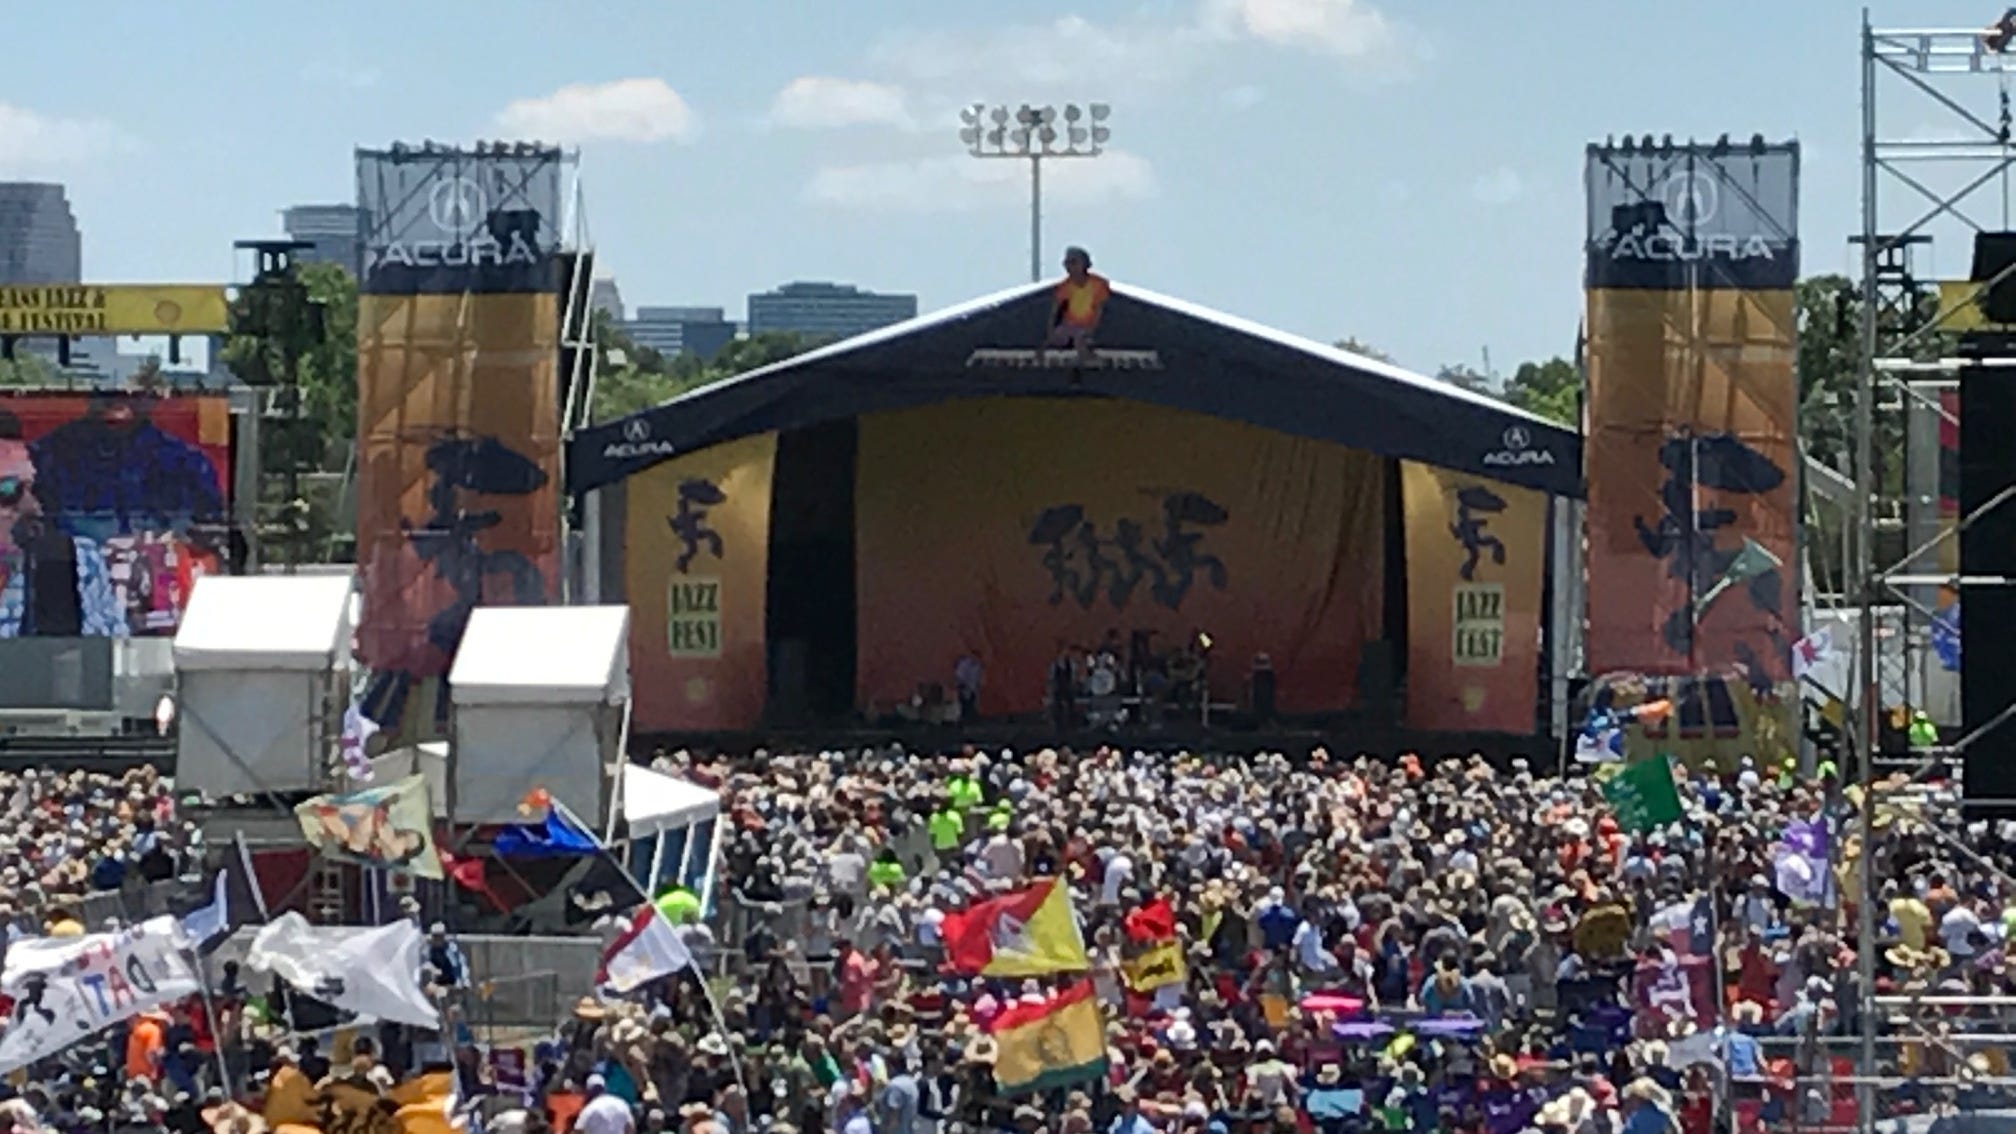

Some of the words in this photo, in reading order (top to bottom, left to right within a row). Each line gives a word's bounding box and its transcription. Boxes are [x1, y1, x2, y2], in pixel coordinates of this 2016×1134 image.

[378, 239, 536, 267] ACURA
[1611, 232, 1775, 260] ACURA
[46, 287, 87, 308] JAZZ
[20, 311, 105, 331] FESTIVAL
[603, 441, 674, 457] ACURA
[1483, 450, 1555, 464] ACURA
[672, 583, 718, 615] JAZZ
[1457, 590, 1501, 623] JAZZ
[672, 621, 717, 650] FEST
[1457, 628, 1502, 658] FEST
